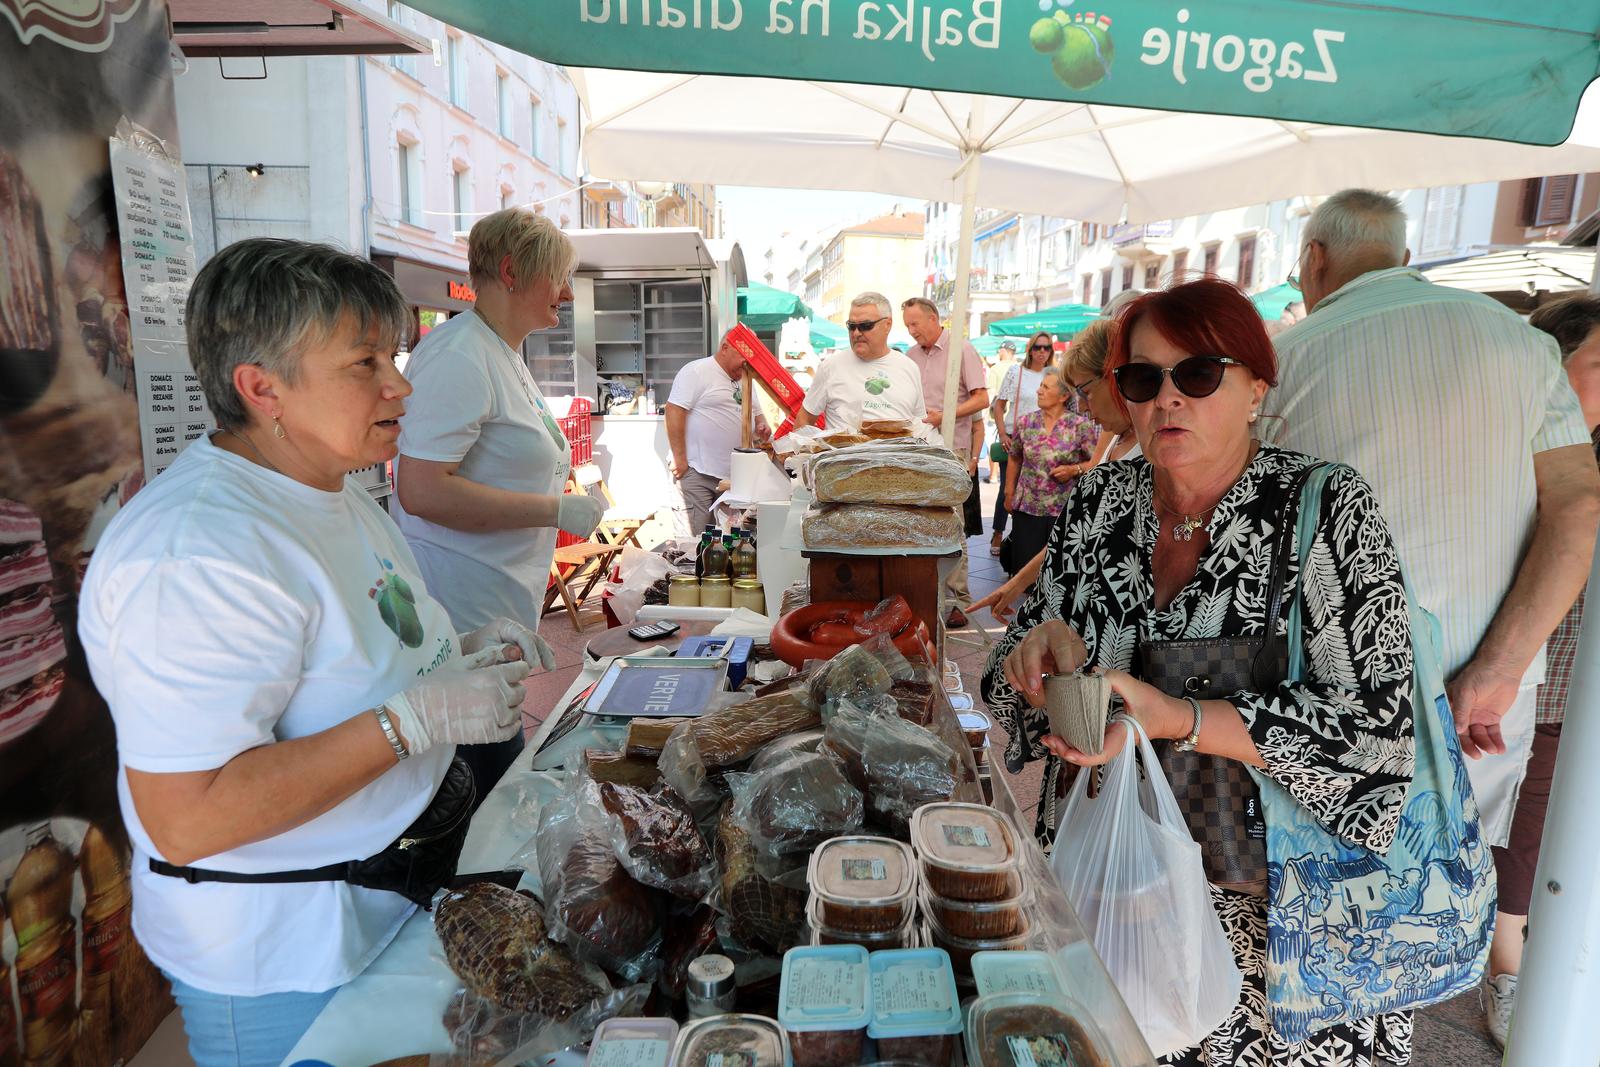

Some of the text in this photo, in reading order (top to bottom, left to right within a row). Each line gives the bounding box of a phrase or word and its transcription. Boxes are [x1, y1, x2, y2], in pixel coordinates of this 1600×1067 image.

[144, 316, 152, 325] 65
[152, 404, 161, 412] 110
[643, 673, 681, 712] VERTIE
